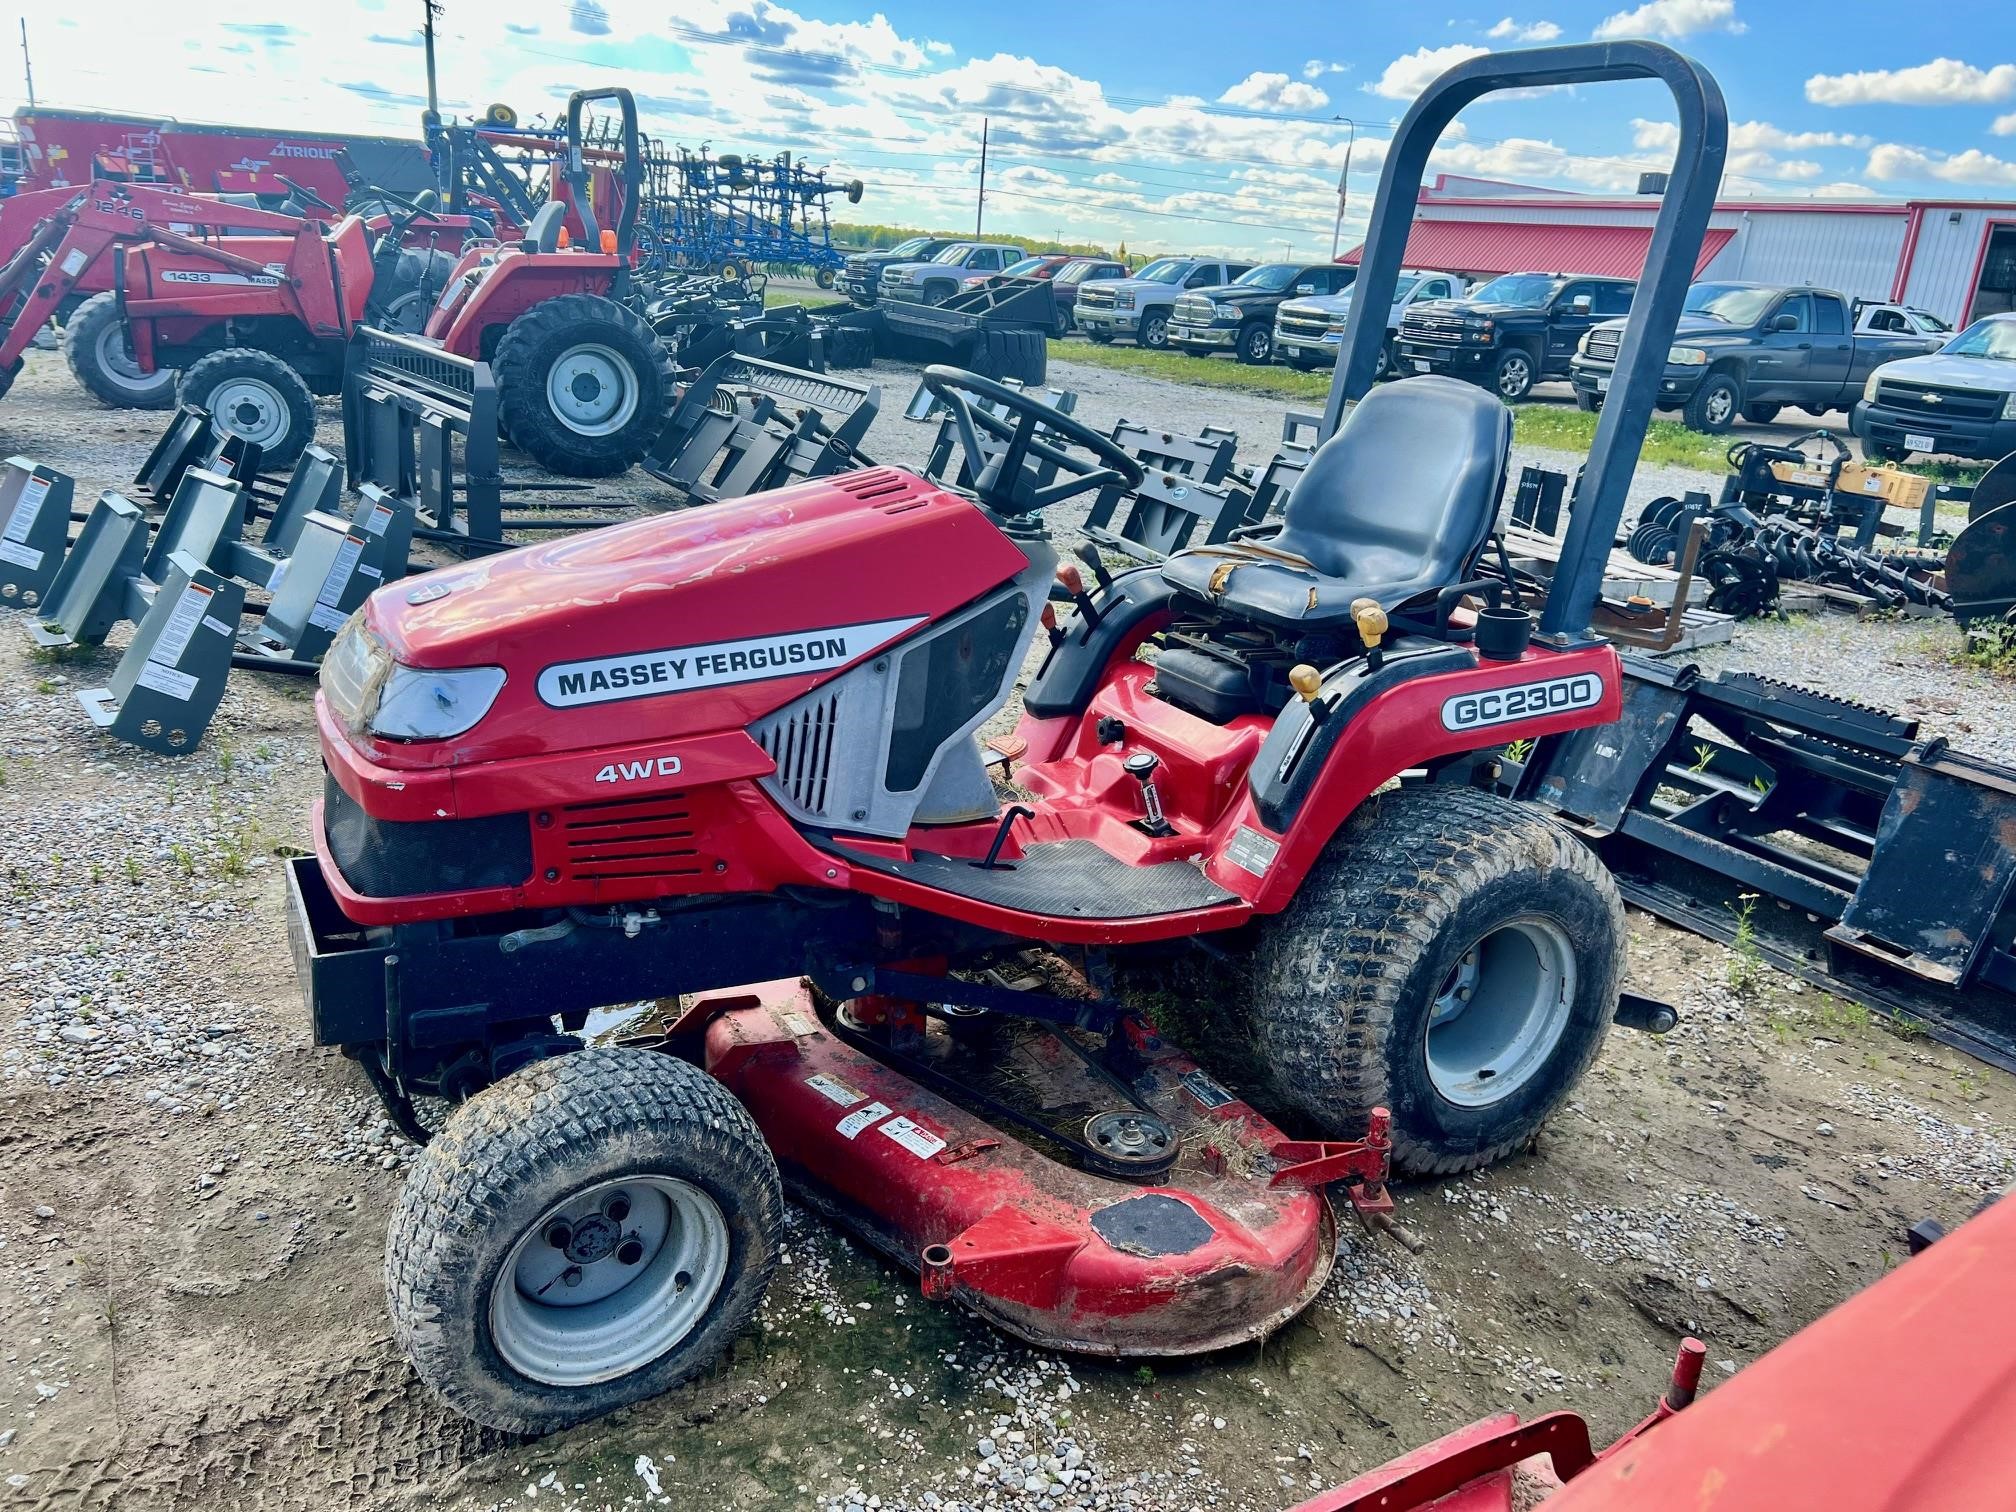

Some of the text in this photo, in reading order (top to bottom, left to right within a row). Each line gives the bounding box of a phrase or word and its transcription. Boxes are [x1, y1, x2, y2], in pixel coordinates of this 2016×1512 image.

[94, 199, 145, 221] 1246
[169, 272, 280, 285] 1433 MASSE
[557, 637, 848, 697] MASSEY FERGUSON
[594, 754, 683, 784] 4WD
